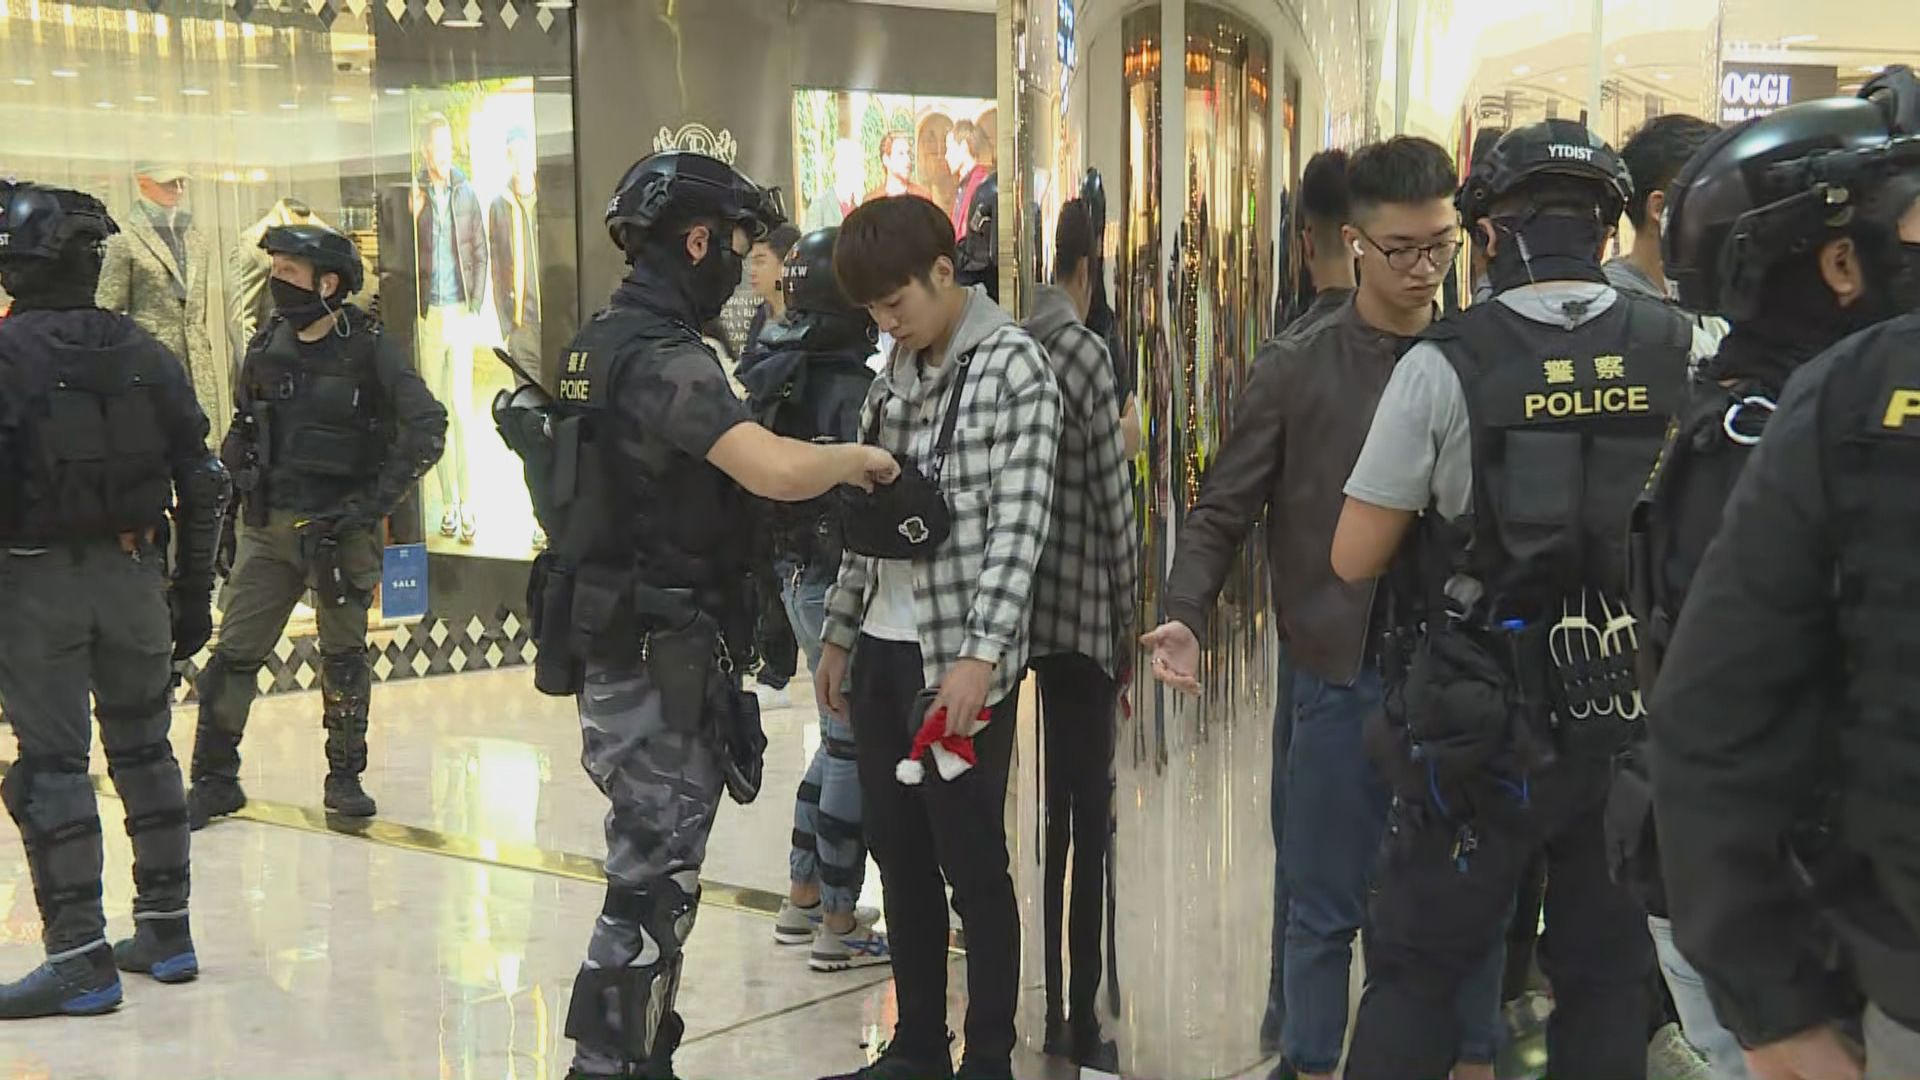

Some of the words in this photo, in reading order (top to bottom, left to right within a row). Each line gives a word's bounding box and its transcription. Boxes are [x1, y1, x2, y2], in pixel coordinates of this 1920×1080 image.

[1722, 72, 1791, 105] OGGI
[1722, 108, 1775, 120] MILAN
[1547, 144, 1593, 161] YTDIST
[1544, 356, 1625, 384] 警察
[1525, 386, 1649, 418] POLICE
[392, 580, 416, 589] SALE
